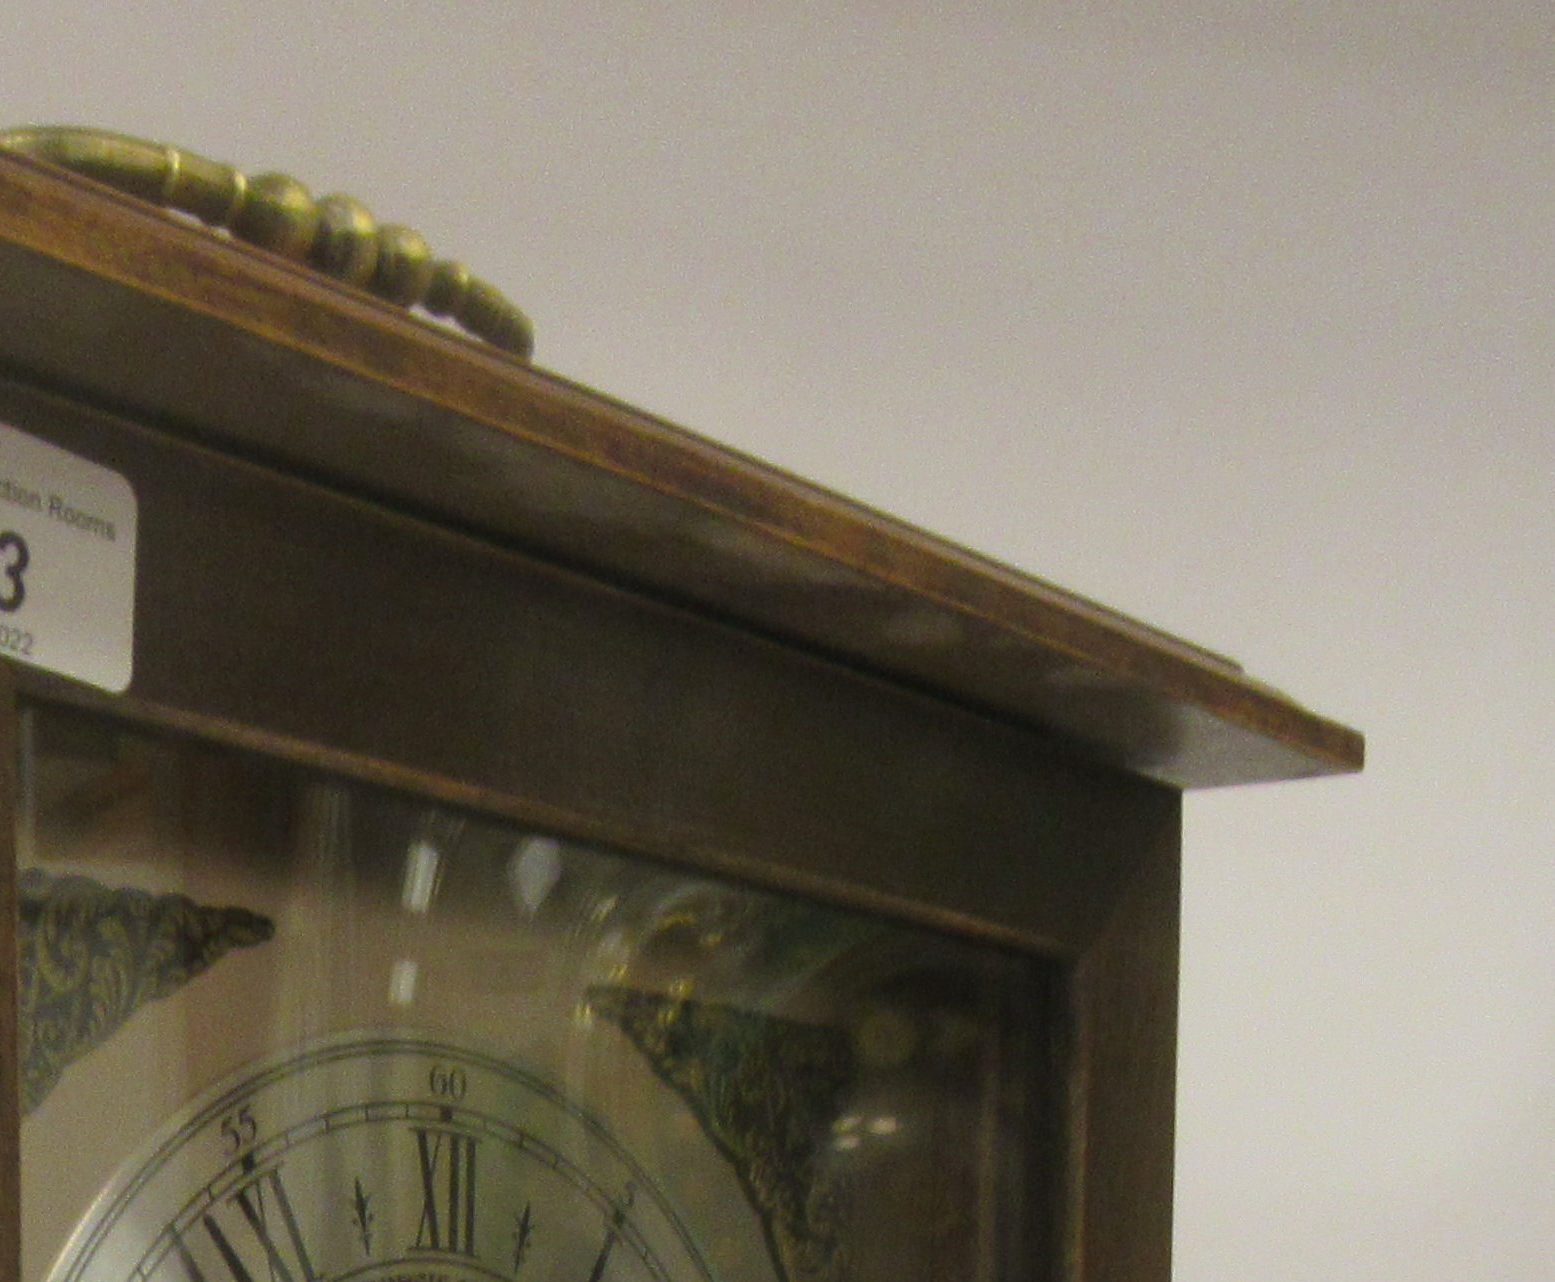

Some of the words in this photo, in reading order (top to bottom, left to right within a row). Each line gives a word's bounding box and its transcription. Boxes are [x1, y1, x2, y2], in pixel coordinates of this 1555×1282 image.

[48, 494, 116, 542] Rooms
[430, 1065, 467, 1099] 60
[221, 1104, 257, 1152] 55
[407, 1125, 482, 1259] XII
